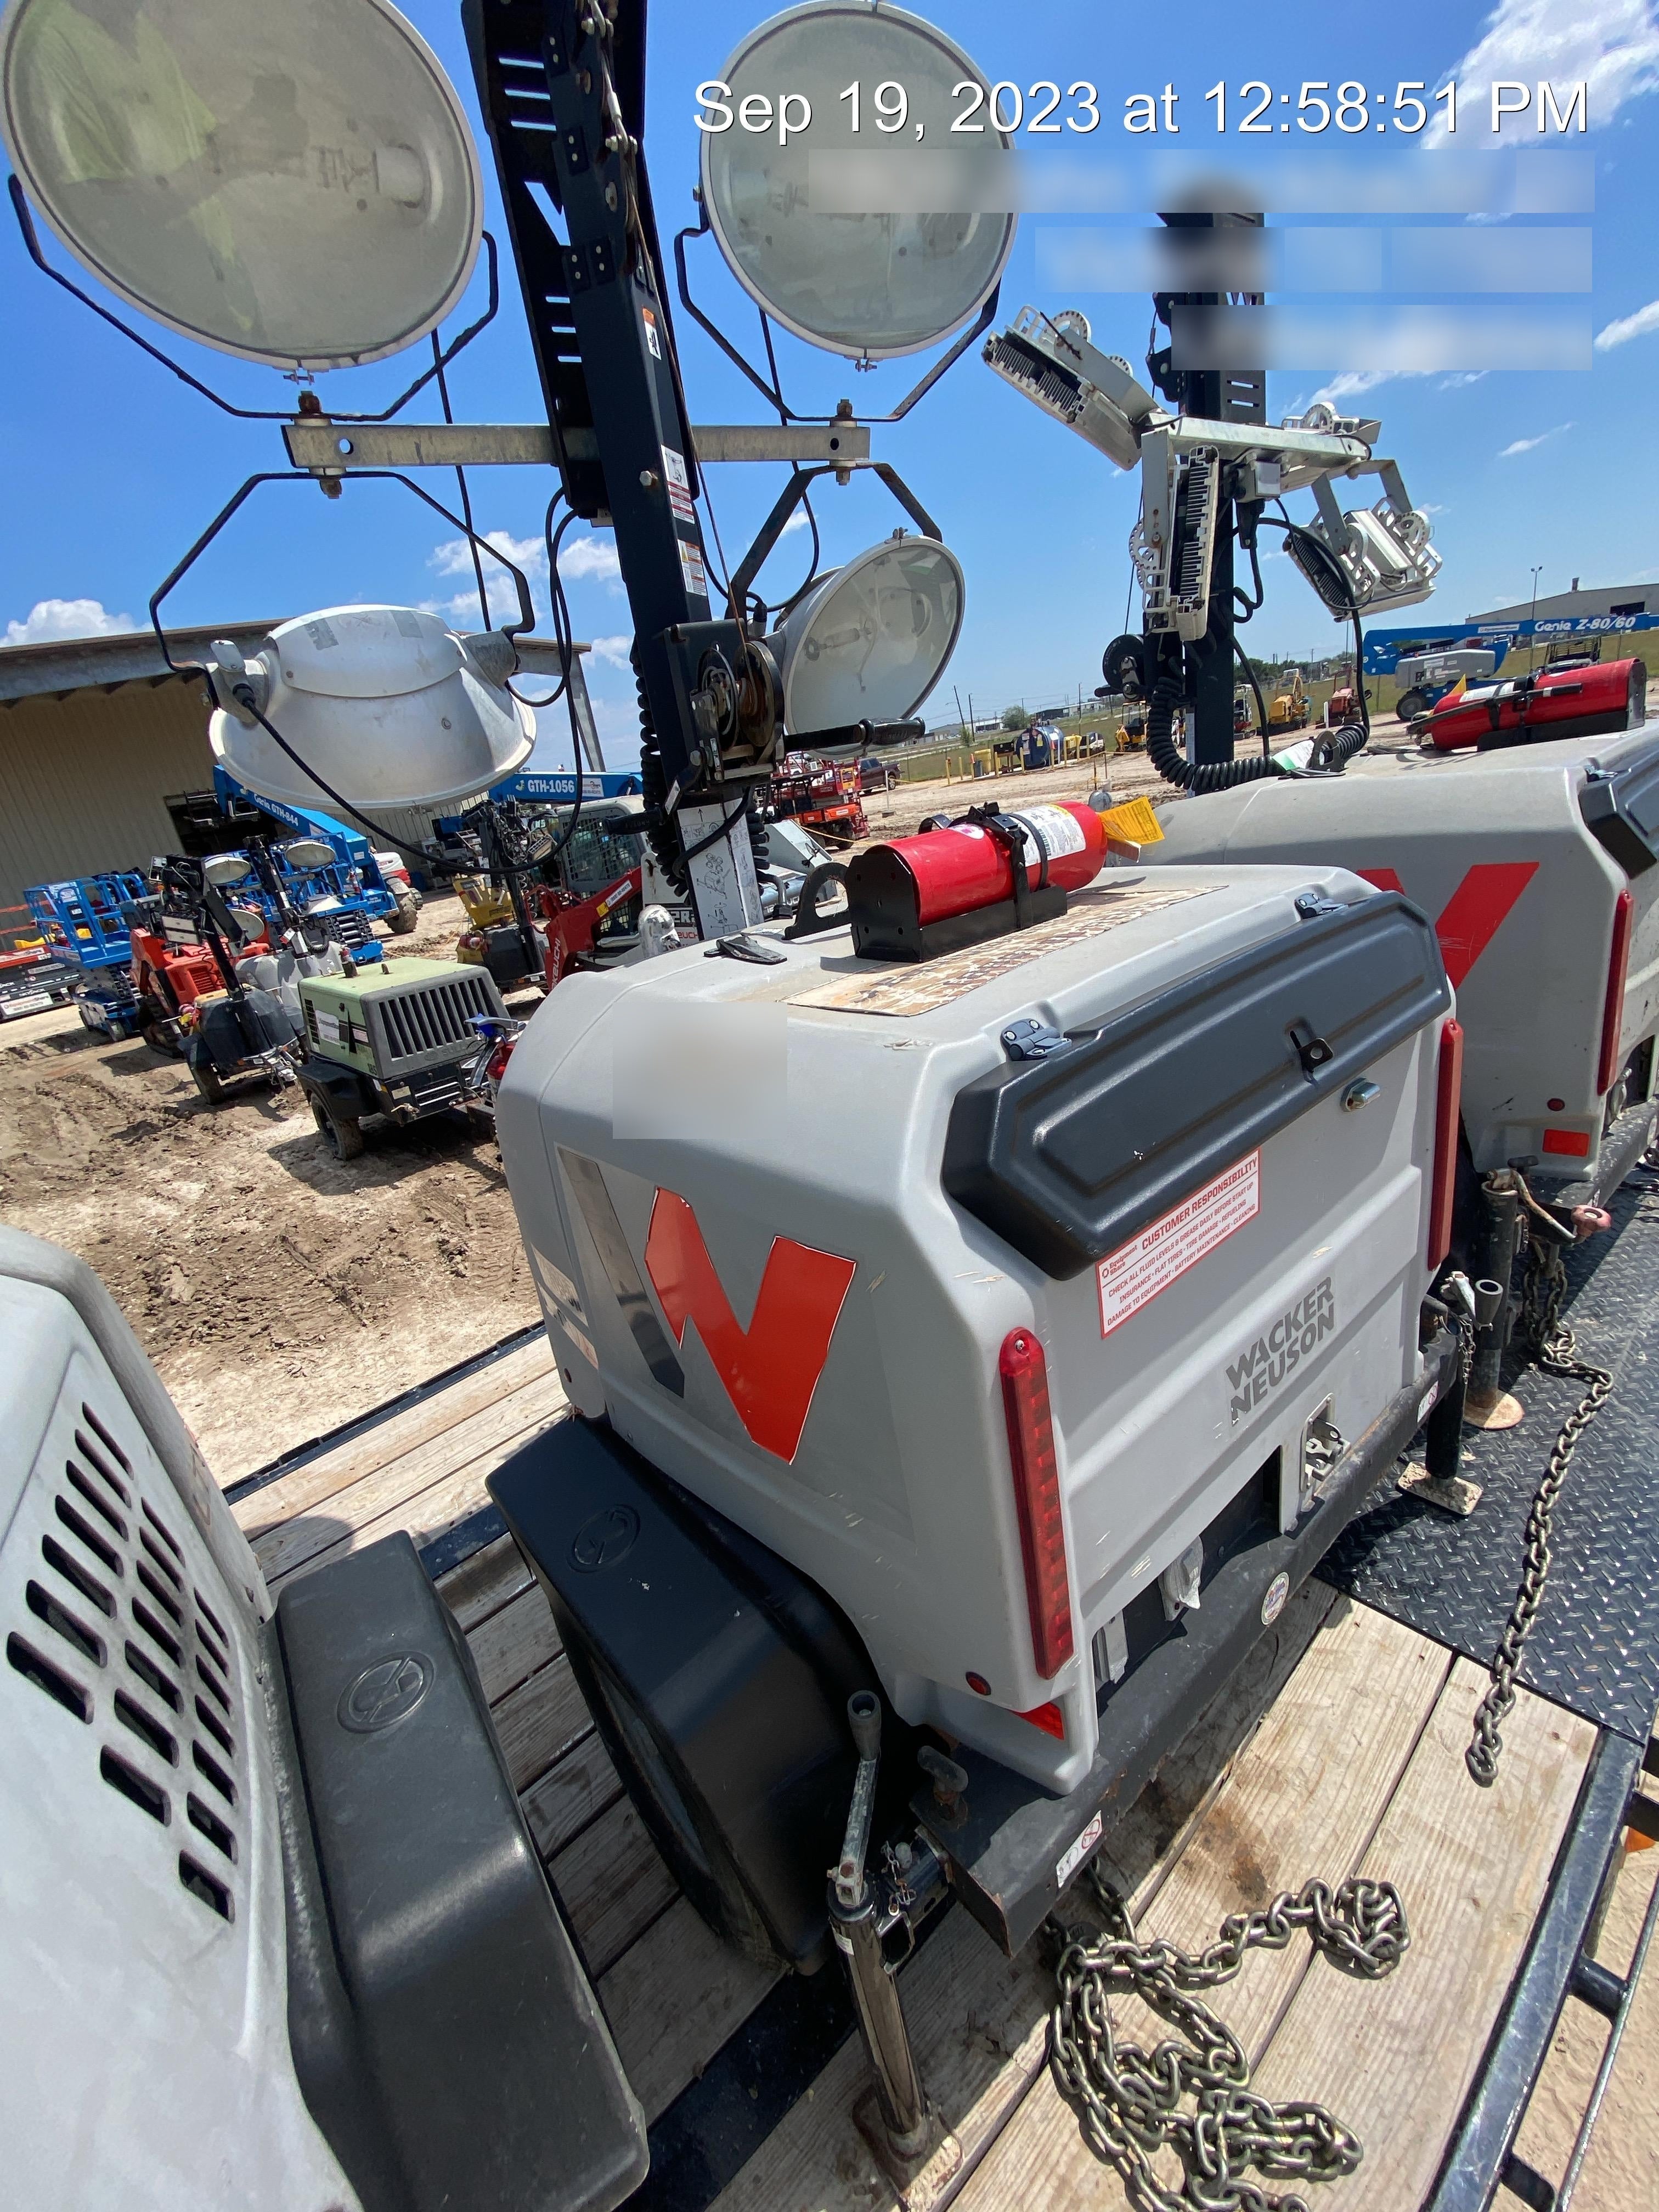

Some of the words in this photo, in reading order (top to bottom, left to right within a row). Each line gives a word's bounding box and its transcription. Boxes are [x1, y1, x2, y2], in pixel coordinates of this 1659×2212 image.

[1534, 620, 1571, 632] Genie
[1575, 616, 1637, 630] Z-80/60
[271, 804, 299, 827] GTH-844
[527, 778, 575, 793] GTH-1056
[1108, 1278, 1128, 1298] CHECK
[1128, 1269, 1139, 1283] ALL
[1139, 1257, 1156, 1275] FLUID
[1156, 1242, 1175, 1262] LEVELS
[1180, 1223, 1199, 1243] GREASE
[1199, 1211, 1214, 1227] DAILY
[1214, 1198, 1232, 1216] BEFORE
[1232, 1187, 1246, 1203] START
[1246, 1181, 1254, 1192] UP
[1142, 1206, 1190, 1250] CUSTOMER
[1192, 1156, 1257, 1214] RESPONSIBILITY
[1107, 1302, 1132, 1327] DAMAGE
[1132, 1295, 1140, 1306] TO
[1141, 1270, 1172, 1300] EQUIPMENT
[1175, 1249, 1197, 1272] BATTERY
[1197, 1223, 1231, 1254] MAINTENANCE
[1233, 1203, 1256, 1226] CLEANING
[1109, 1245, 1138, 1269] Equipment
[1109, 1261, 1126, 1276] Share
[1119, 1274, 1152, 1304] INSURANCE
[1155, 1261, 1167, 1276] FLAT
[1168, 1248, 1183, 1265] TIRES
[1186, 1236, 1198, 1250] TIRE
[1198, 1220, 1219, 1240] DAMAGE
[1221, 1199, 1247, 1223] REFUELING
[1225, 1276, 1334, 1390] WACKER
[1230, 1301, 1335, 1426] NEUSON
